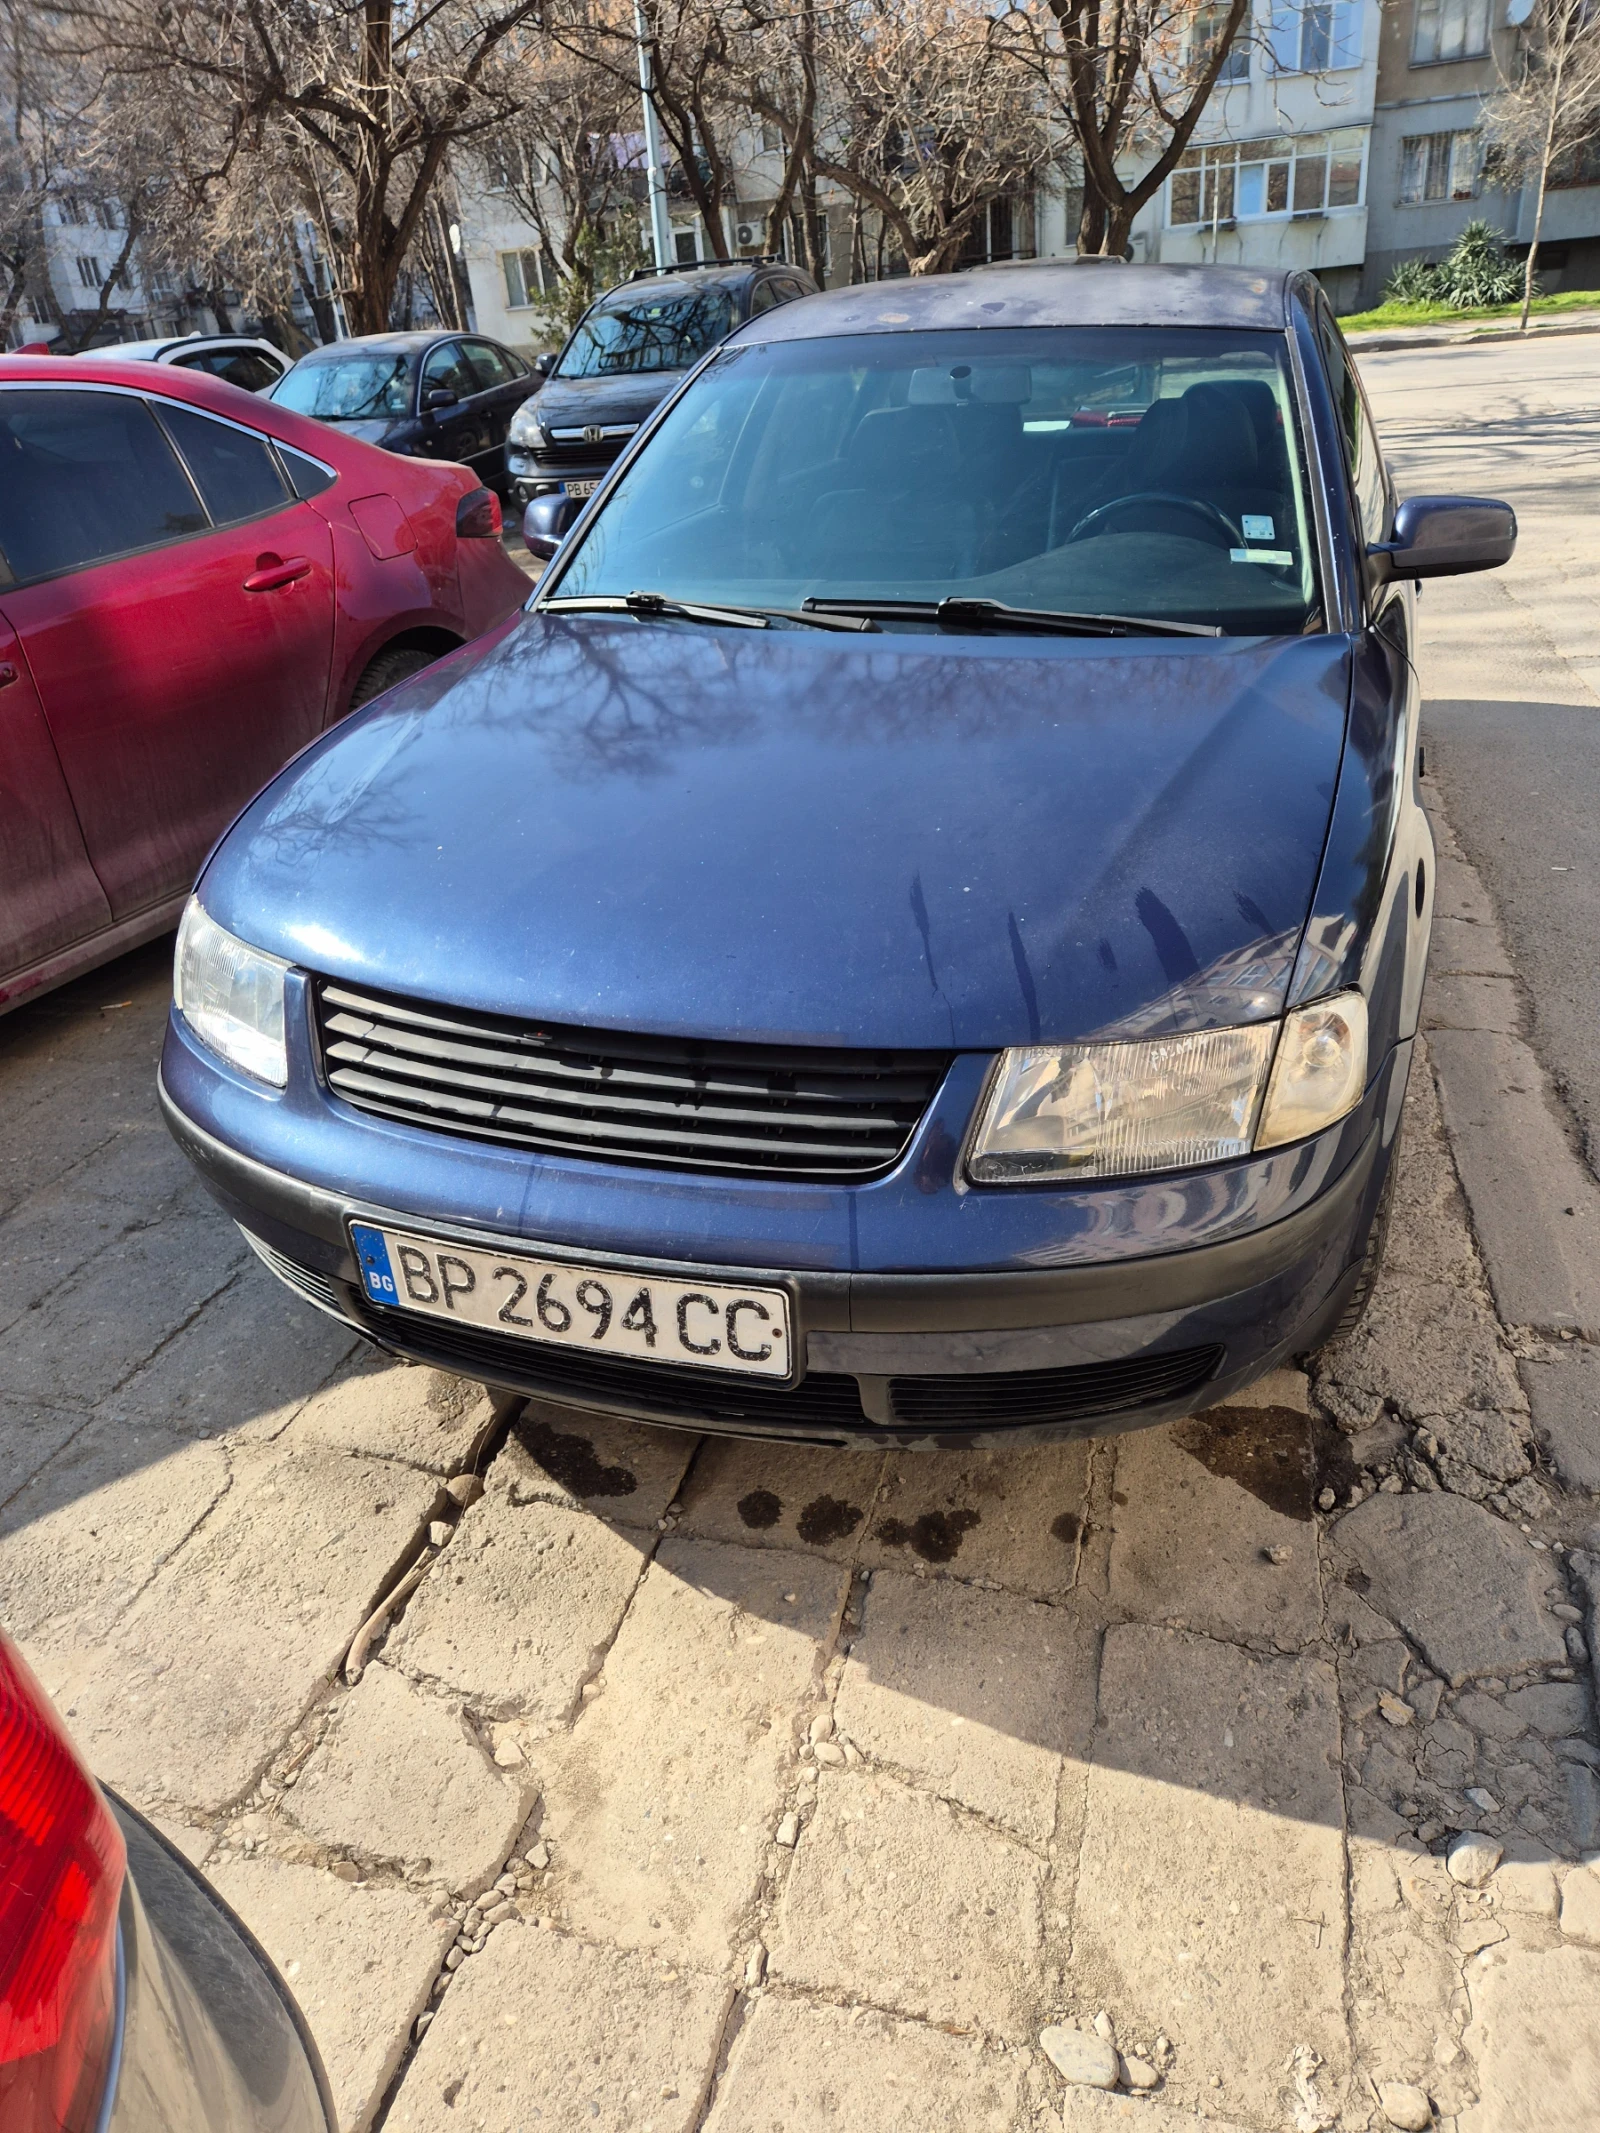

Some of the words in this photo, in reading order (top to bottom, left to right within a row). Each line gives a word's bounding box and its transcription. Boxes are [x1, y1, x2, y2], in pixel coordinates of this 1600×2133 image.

[567, 483, 582, 496] PB
[369, 1271, 394, 1292] BG
[396, 1243, 476, 1311] BP
[492, 1265, 659, 1349] 2694
[676, 1293, 772, 1362] CC
